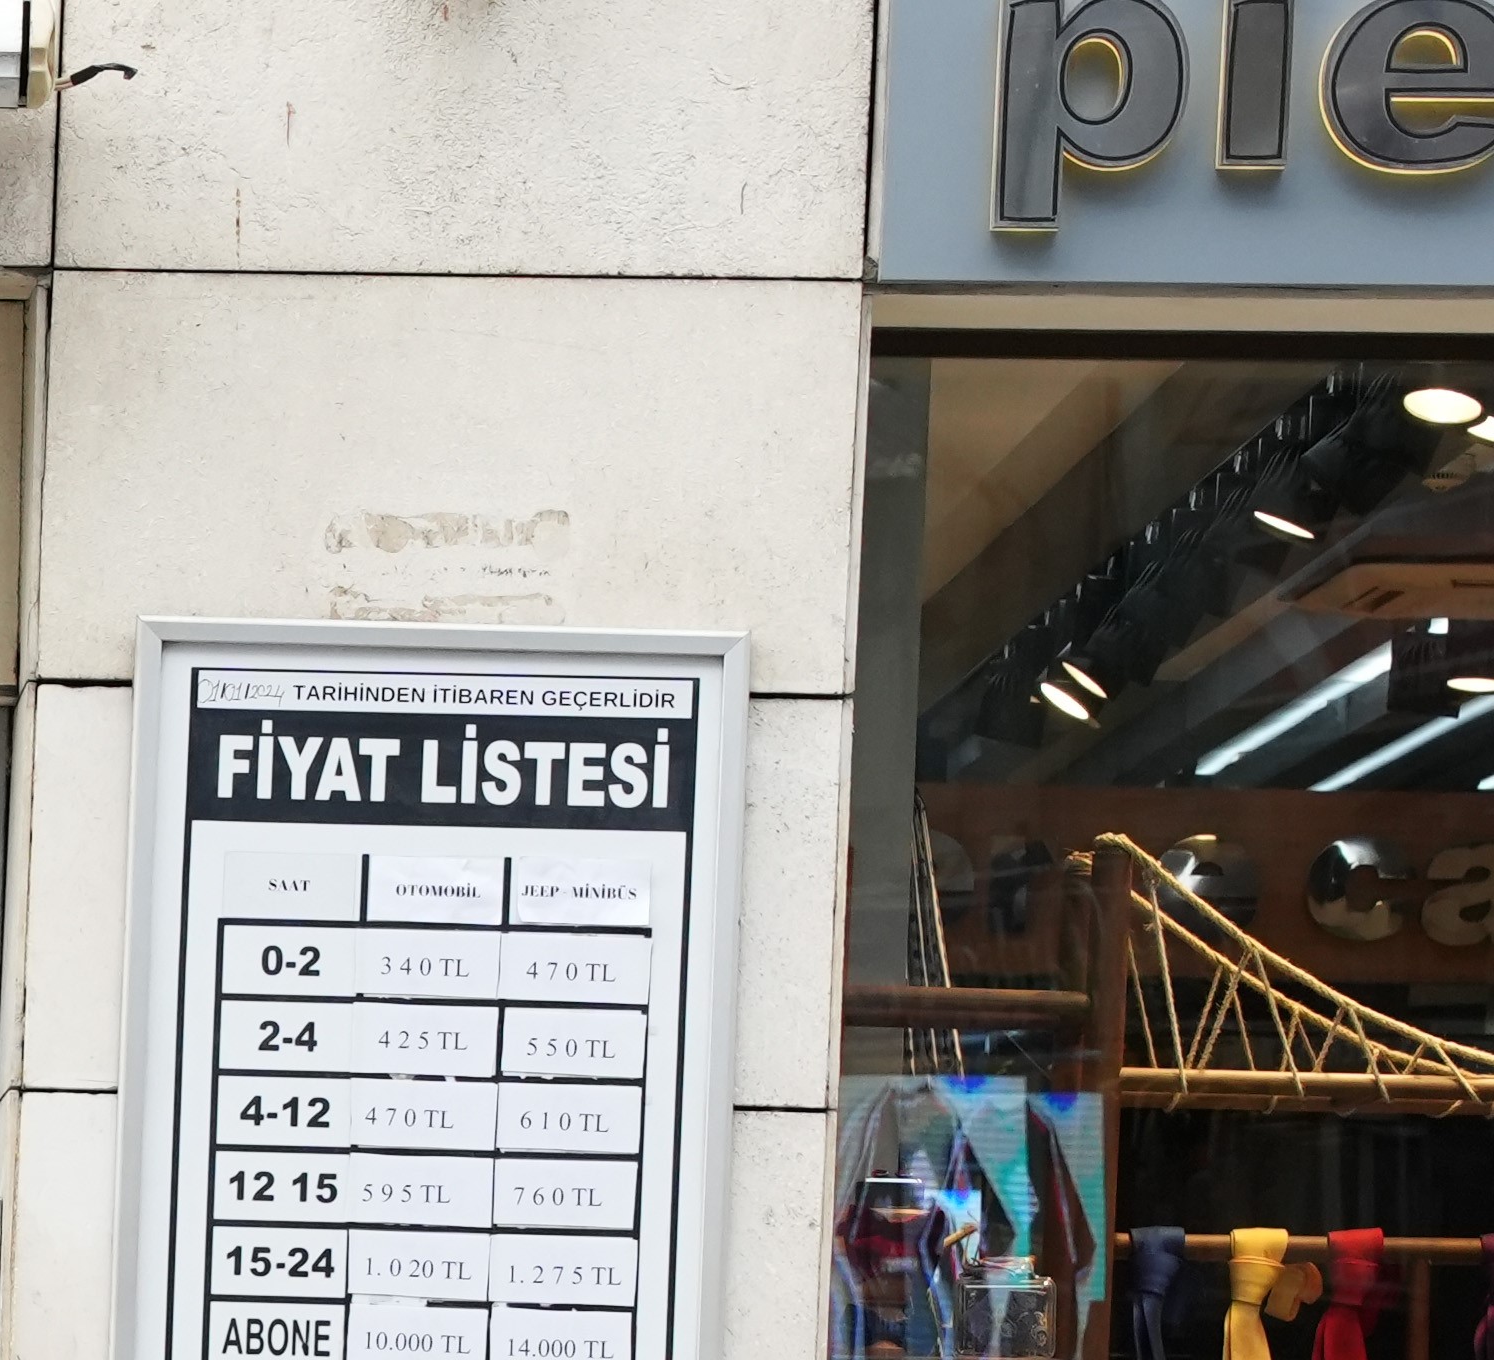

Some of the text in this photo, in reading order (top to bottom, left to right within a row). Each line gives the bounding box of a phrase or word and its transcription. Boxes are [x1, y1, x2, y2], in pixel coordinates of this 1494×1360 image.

[292, 683, 676, 710] TARİHİNDEN İTİBAREN GEÇERLİDİR
[217, 719, 670, 809] FİYAT LİSTESİ
[268, 878, 311, 893] SAAT
[395, 882, 482, 899] OTOMOBİL
[522, 885, 559, 898] JEEP
[573, 884, 637, 900] MİNİBÜS
[261, 945, 321, 977] 0-2
[258, 1020, 317, 1052] 2-4
[240, 1095, 330, 1128] 4-12
[228, 1170, 338, 1204] 12 15
[226, 1245, 335, 1278] 15-24
[222, 1318, 330, 1357] ABONE
